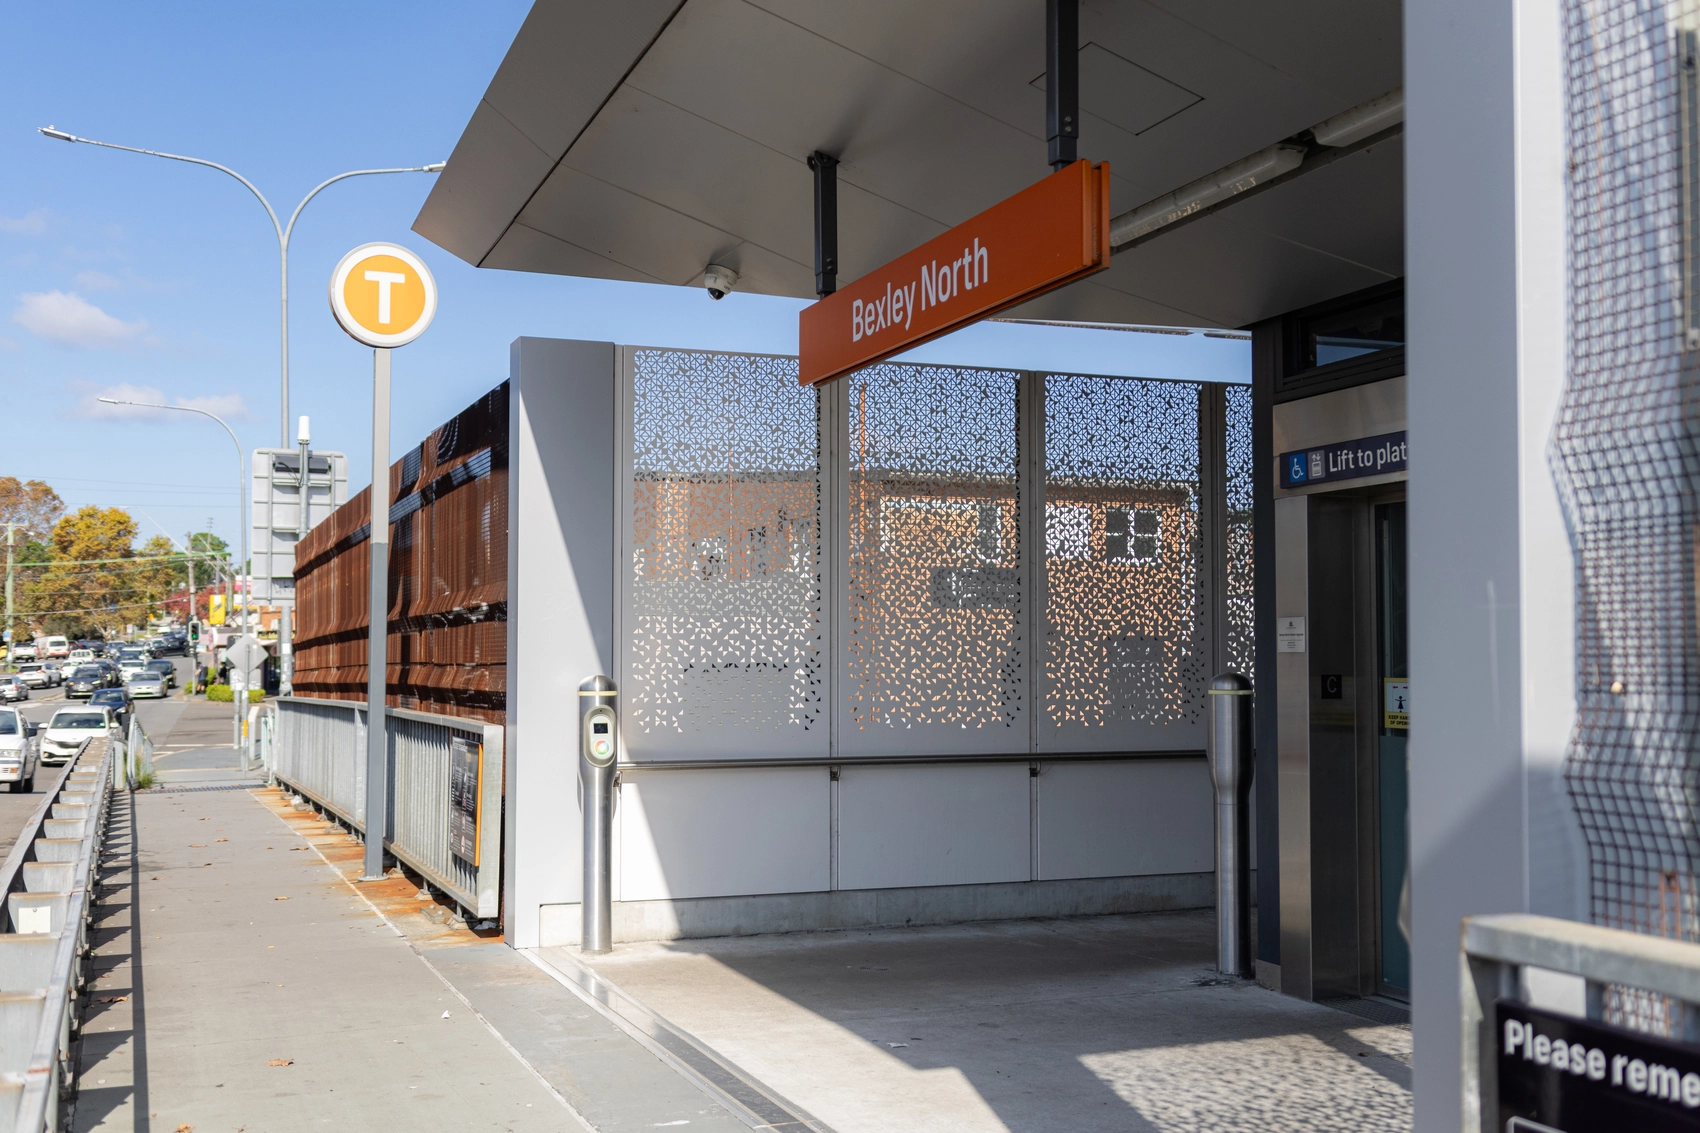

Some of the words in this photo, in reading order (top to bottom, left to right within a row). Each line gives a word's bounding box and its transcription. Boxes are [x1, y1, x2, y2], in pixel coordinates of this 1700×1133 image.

[364, 270, 405, 324] T
[852, 281, 916, 342] Bexley
[921, 237, 989, 311] North
[1329, 450, 1355, 473] Lift
[1357, 448, 1374, 467] to
[1377, 442, 1408, 470] plat
[1327, 676, 1337, 693] C
[1504, 1018, 1606, 1081] Please
[1611, 1053, 1700, 1108] reme
